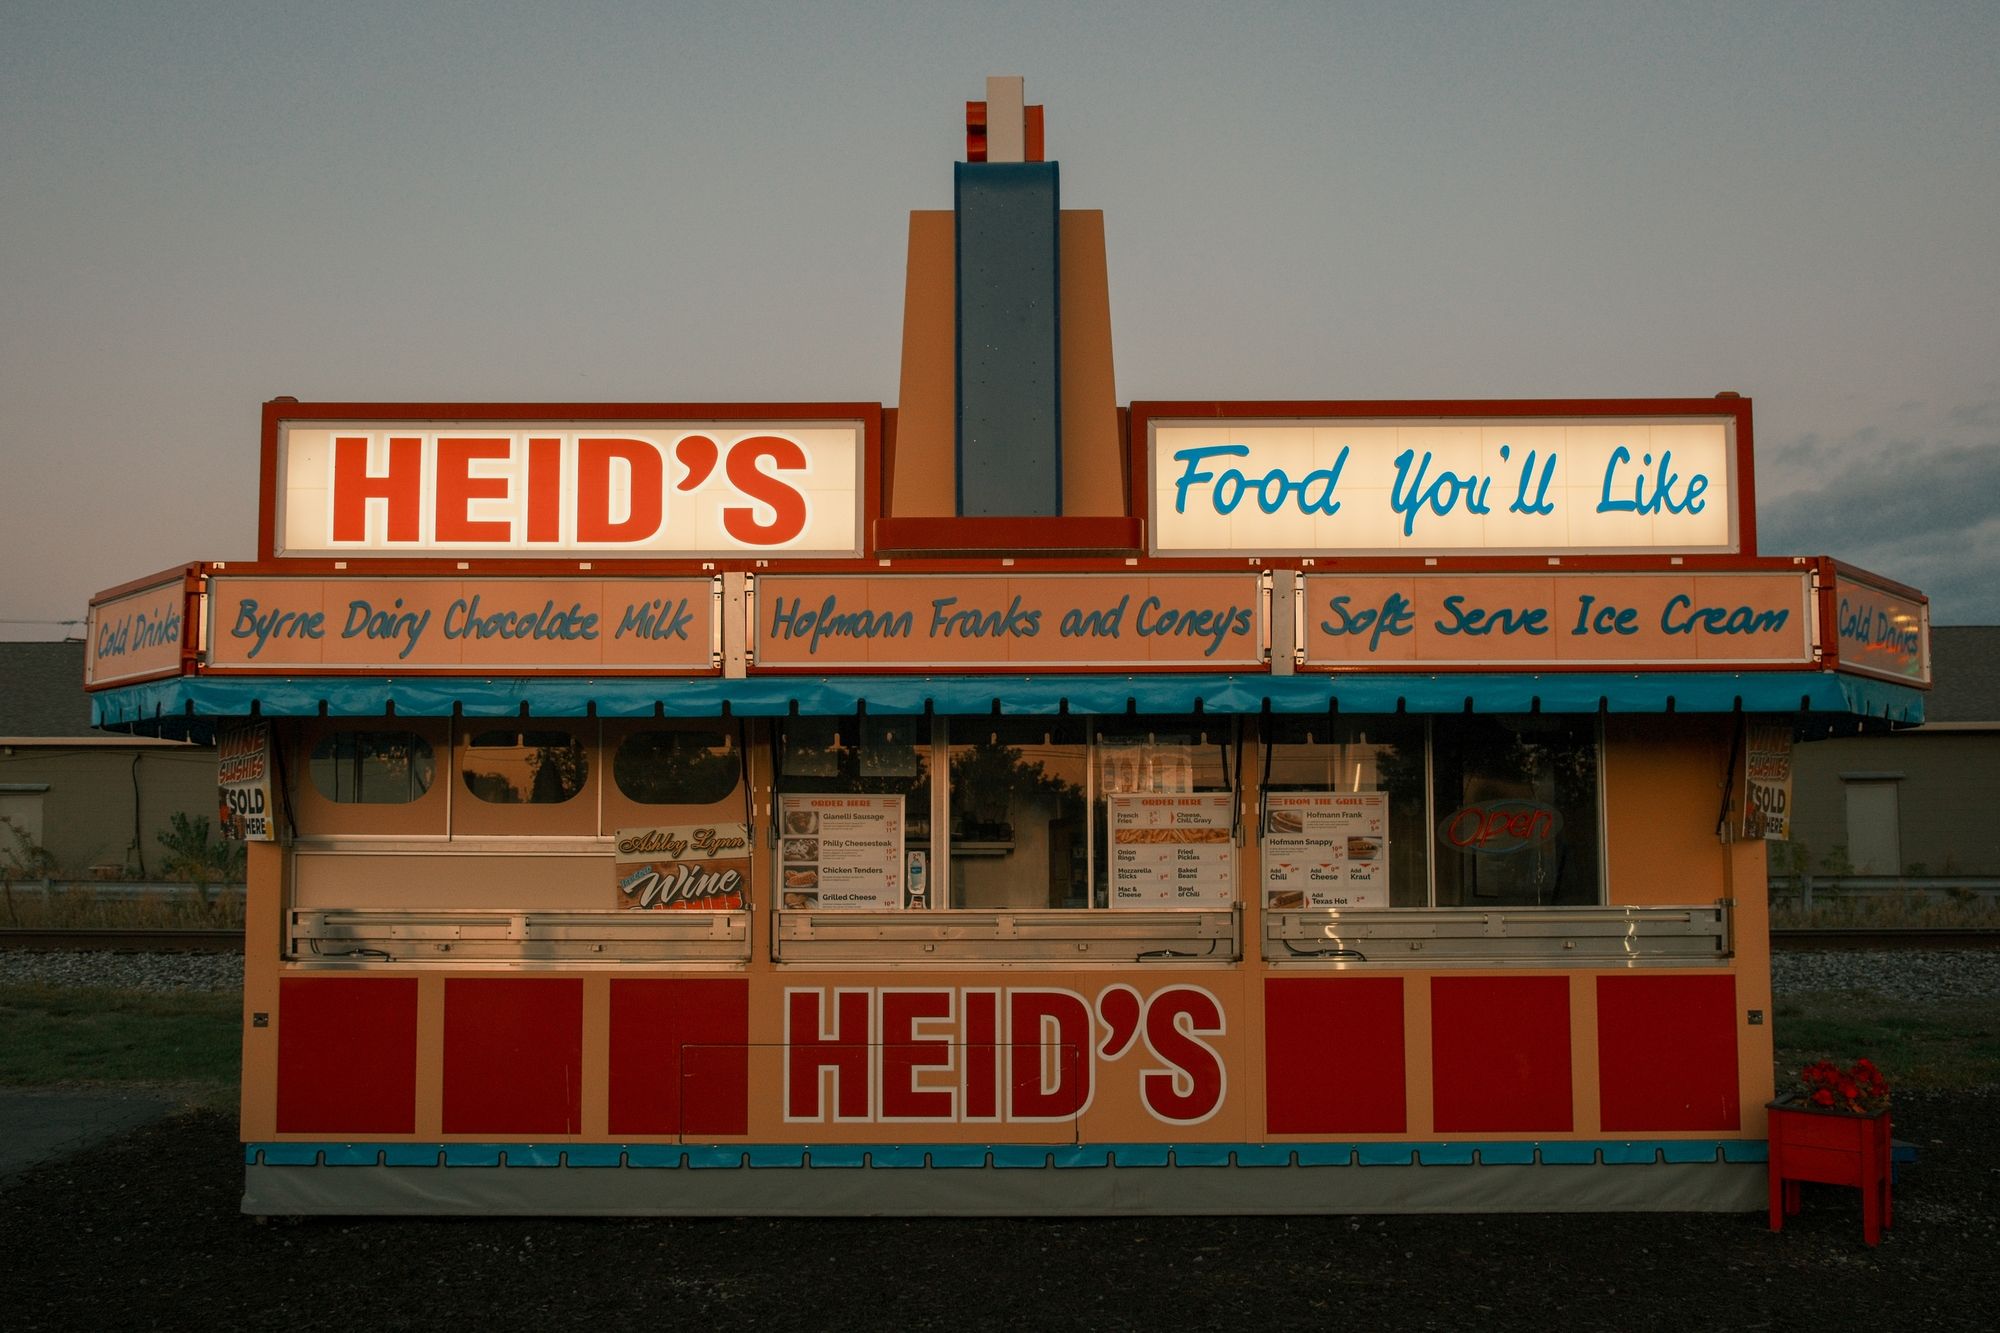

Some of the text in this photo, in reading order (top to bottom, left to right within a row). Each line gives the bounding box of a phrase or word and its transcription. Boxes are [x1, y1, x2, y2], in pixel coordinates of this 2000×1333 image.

[329, 433, 811, 547] HEID'S
[1173, 444, 1709, 537] Food You'll Like
[97, 602, 181, 659] Cold Drinks
[230, 594, 695, 659] Byrne Dairy Chocolate Milk
[770, 594, 1254, 657] Hofmann Franks and Coneys
[1320, 592, 1790, 652] Soft Serve Ice Cream
[1838, 598, 1918, 656] Cold Drinks
[229, 788, 265, 815] SOLD
[853, 813, 885, 821] Sausage
[1754, 785, 1786, 813] SOLD
[245, 817, 266, 834] HERE
[618, 828, 745, 858] Ashley Lynn
[823, 840, 844, 848] Philly
[1305, 839, 1333, 848] Snappy
[1447, 805, 1553, 848] Open
[1766, 816, 1784, 833] HERE
[622, 864, 742, 906] Wine
[784, 983, 1226, 1126] HEID'S
